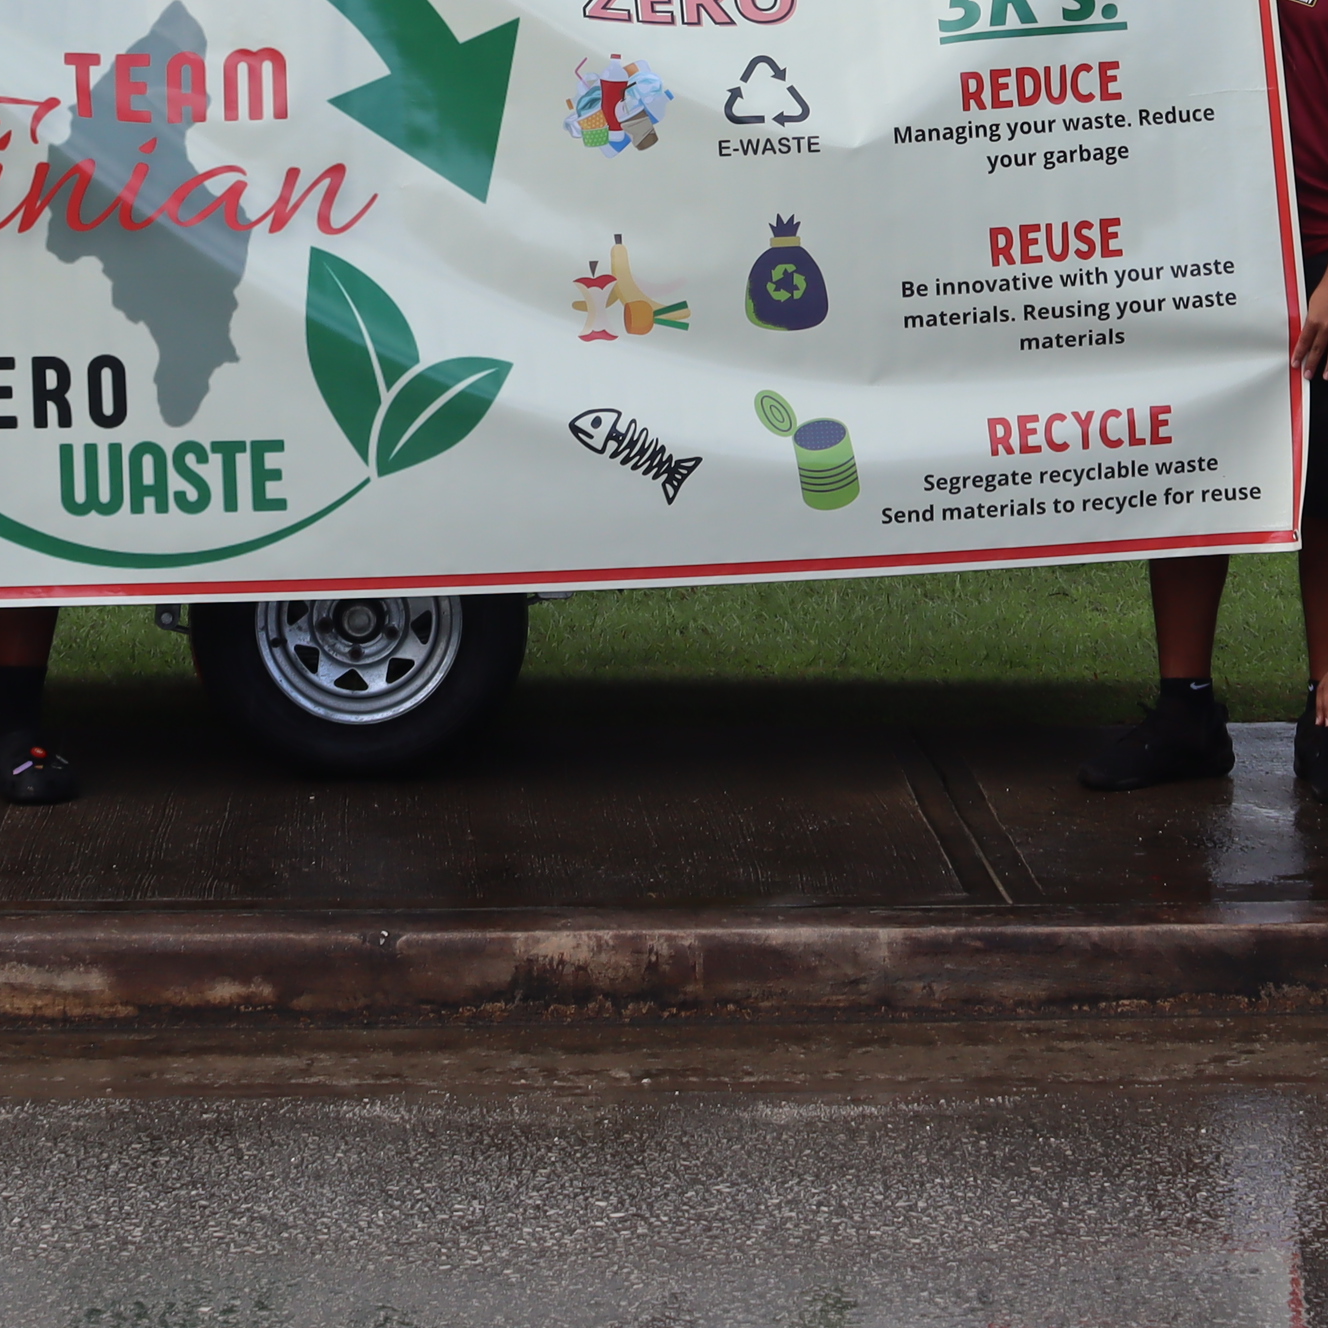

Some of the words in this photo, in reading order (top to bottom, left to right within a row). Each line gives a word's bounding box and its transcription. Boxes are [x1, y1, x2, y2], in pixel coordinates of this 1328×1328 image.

[64, 46, 289, 124] TEAM
[960, 60, 1123, 112] REDUCE
[893, 120, 1002, 145] Managing
[1006, 119, 1056, 142] your
[1062, 112, 1132, 132] waste.
[1138, 105, 1215, 126] Reduce
[717, 135, 821, 157] E-WASTE
[986, 152, 1037, 175] your
[1043, 144, 1129, 170] garbage
[989, 217, 1124, 267] REUSE
[901, 281, 929, 298] Be
[935, 272, 1053, 296] innovative
[1059, 266, 1108, 288] with
[1114, 266, 1164, 289] your
[1170, 259, 1235, 279] waste
[903, 305, 1016, 329] materials.
[1023, 300, 1111, 322] Reusing
[1115, 297, 1166, 320] your
[1171, 290, 1237, 310] waste
[1020, 327, 1125, 351] materials
[987, 405, 1173, 457] RECYCLE
[59, 439, 288, 517] WASTE
[923, 470, 1033, 495] Segregate
[1039, 459, 1149, 487] recyclable
[1155, 456, 1219, 476] waste
[881, 504, 934, 525] Send
[942, 497, 1047, 521] materials
[1052, 498, 1075, 514] to
[1082, 489, 1158, 515] recycle
[1163, 487, 1195, 506] for
[1201, 486, 1261, 503] reuse
